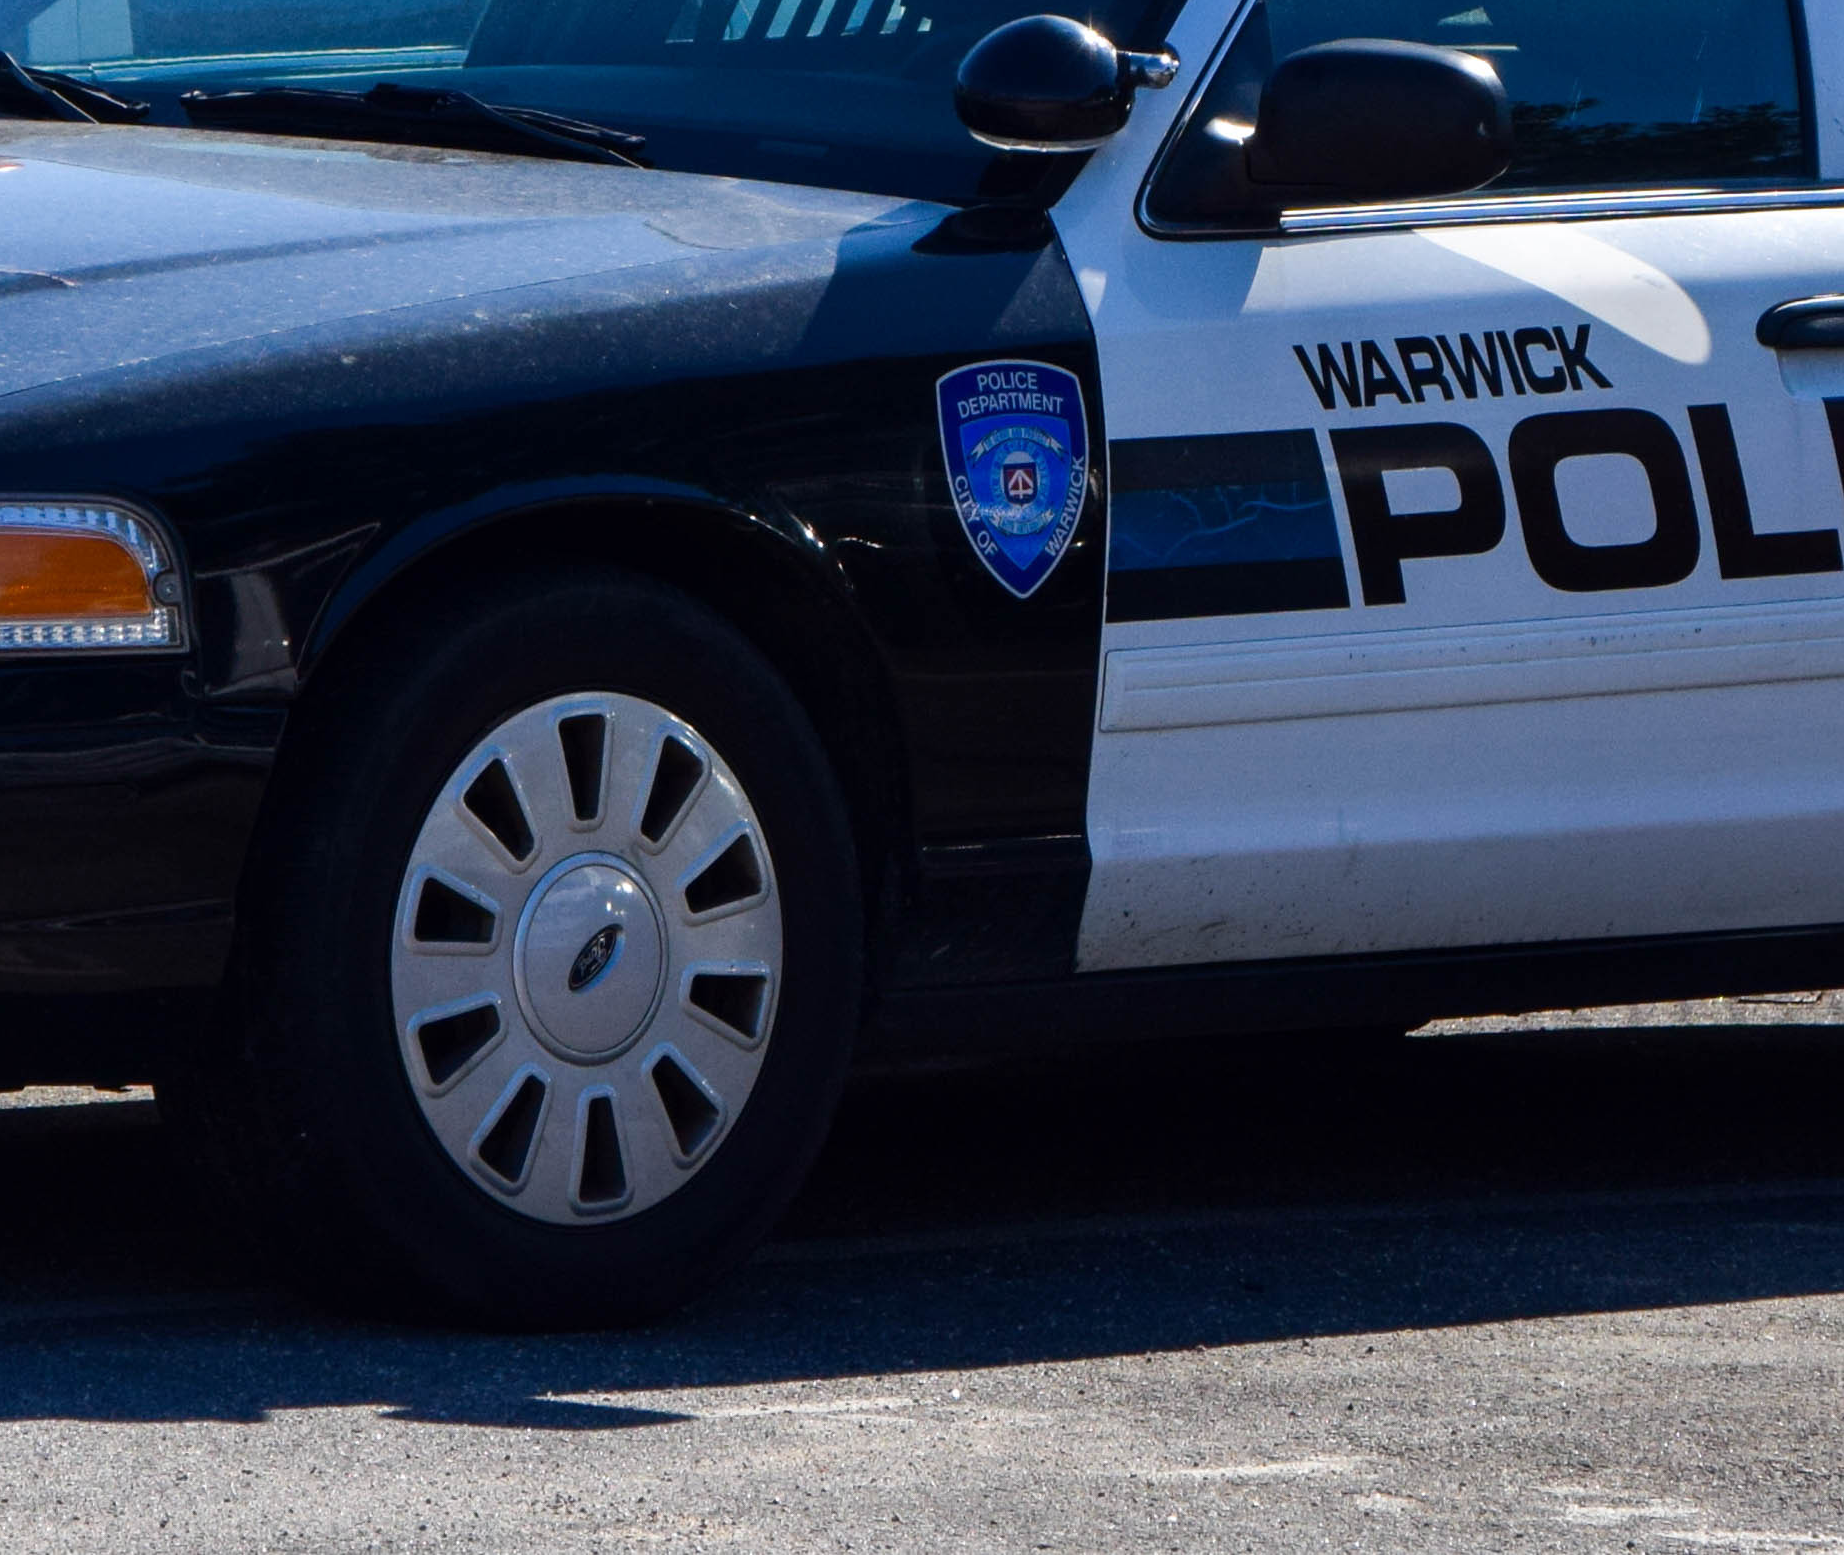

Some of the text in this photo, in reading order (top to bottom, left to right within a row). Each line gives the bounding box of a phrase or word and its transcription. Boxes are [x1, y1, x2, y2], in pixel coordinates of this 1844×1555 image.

[977, 371, 1039, 392] POLICE
[1292, 323, 1614, 411] WARWICK
[957, 392, 1064, 419] DEPARTMENT
[954, 475, 981, 524] CITY
[977, 530, 999, 558] OF
[1044, 455, 1086, 558] WARWICK
